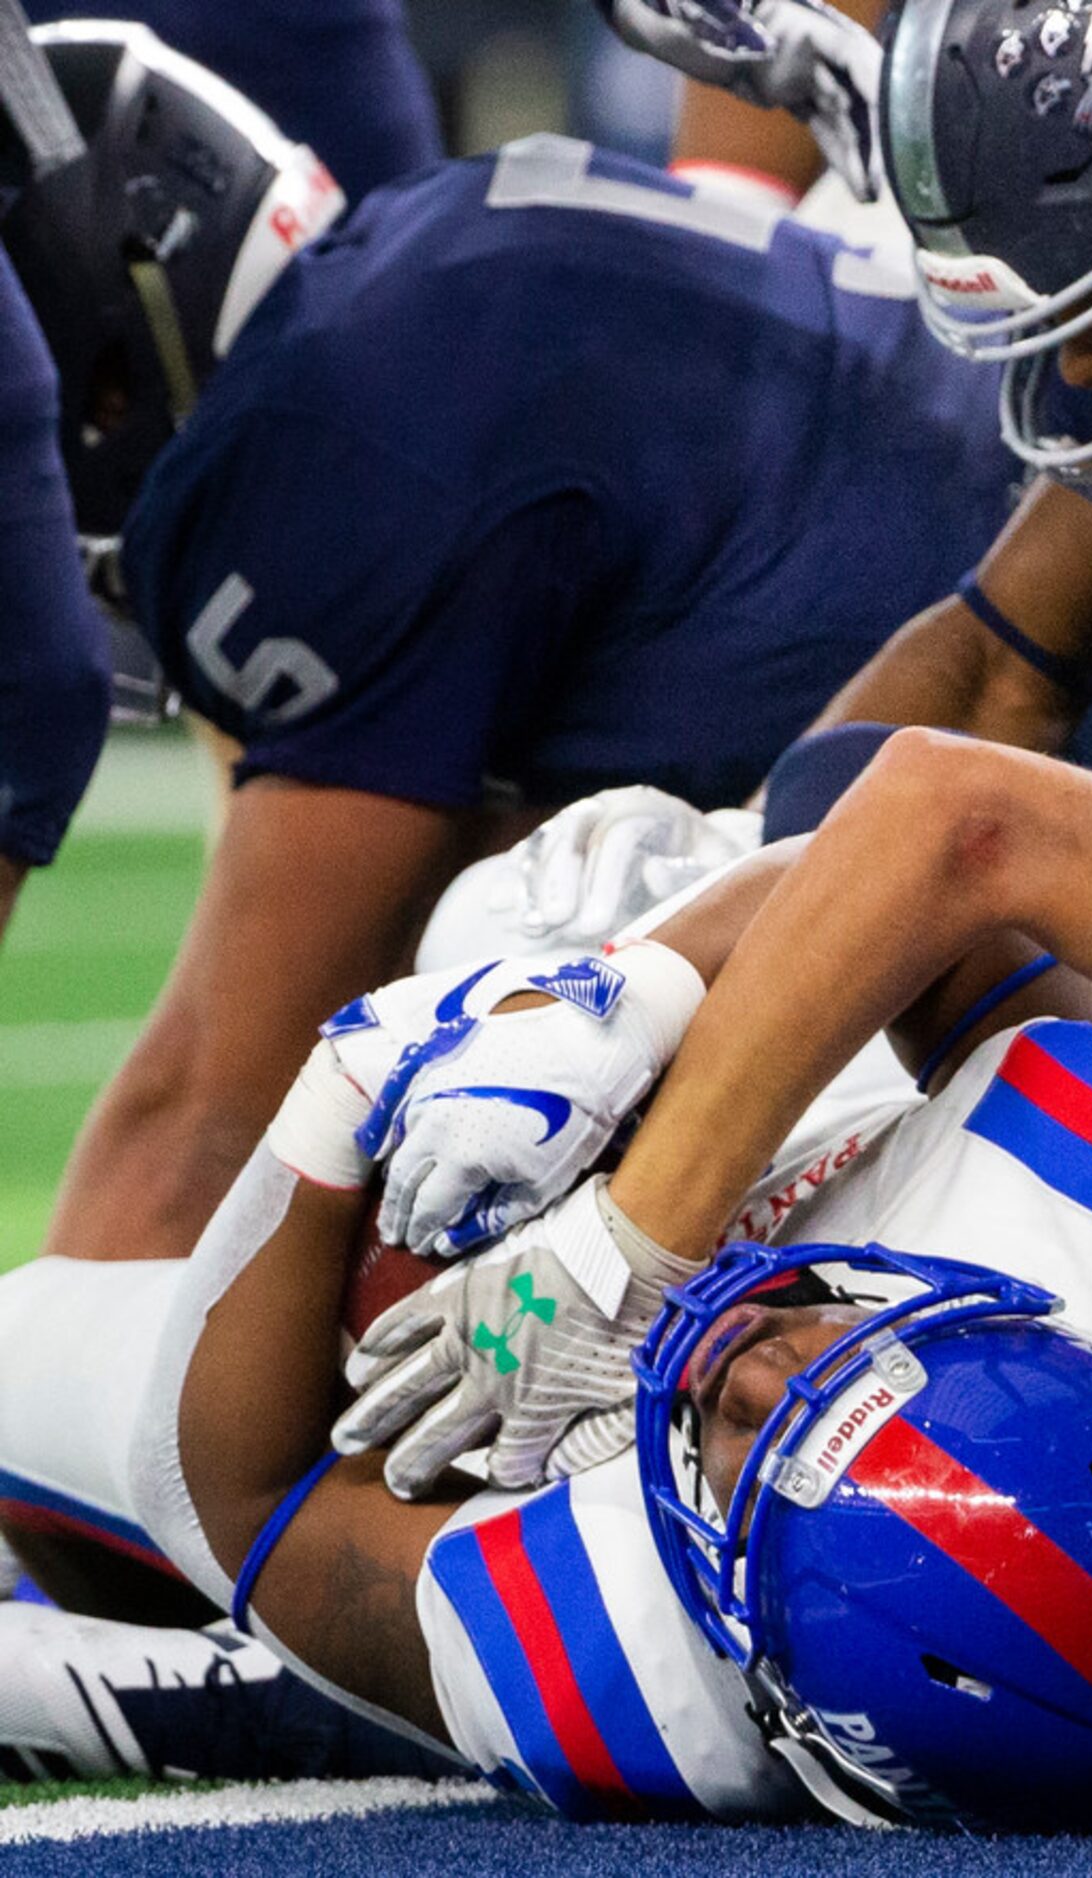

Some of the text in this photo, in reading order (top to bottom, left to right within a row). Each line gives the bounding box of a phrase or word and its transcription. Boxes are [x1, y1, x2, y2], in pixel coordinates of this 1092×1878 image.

[185, 571, 339, 726] 5
[715, 1132, 866, 1250] PANT
[816, 1387, 895, 1475] Riddell
[817, 1707, 940, 1798] PAN
